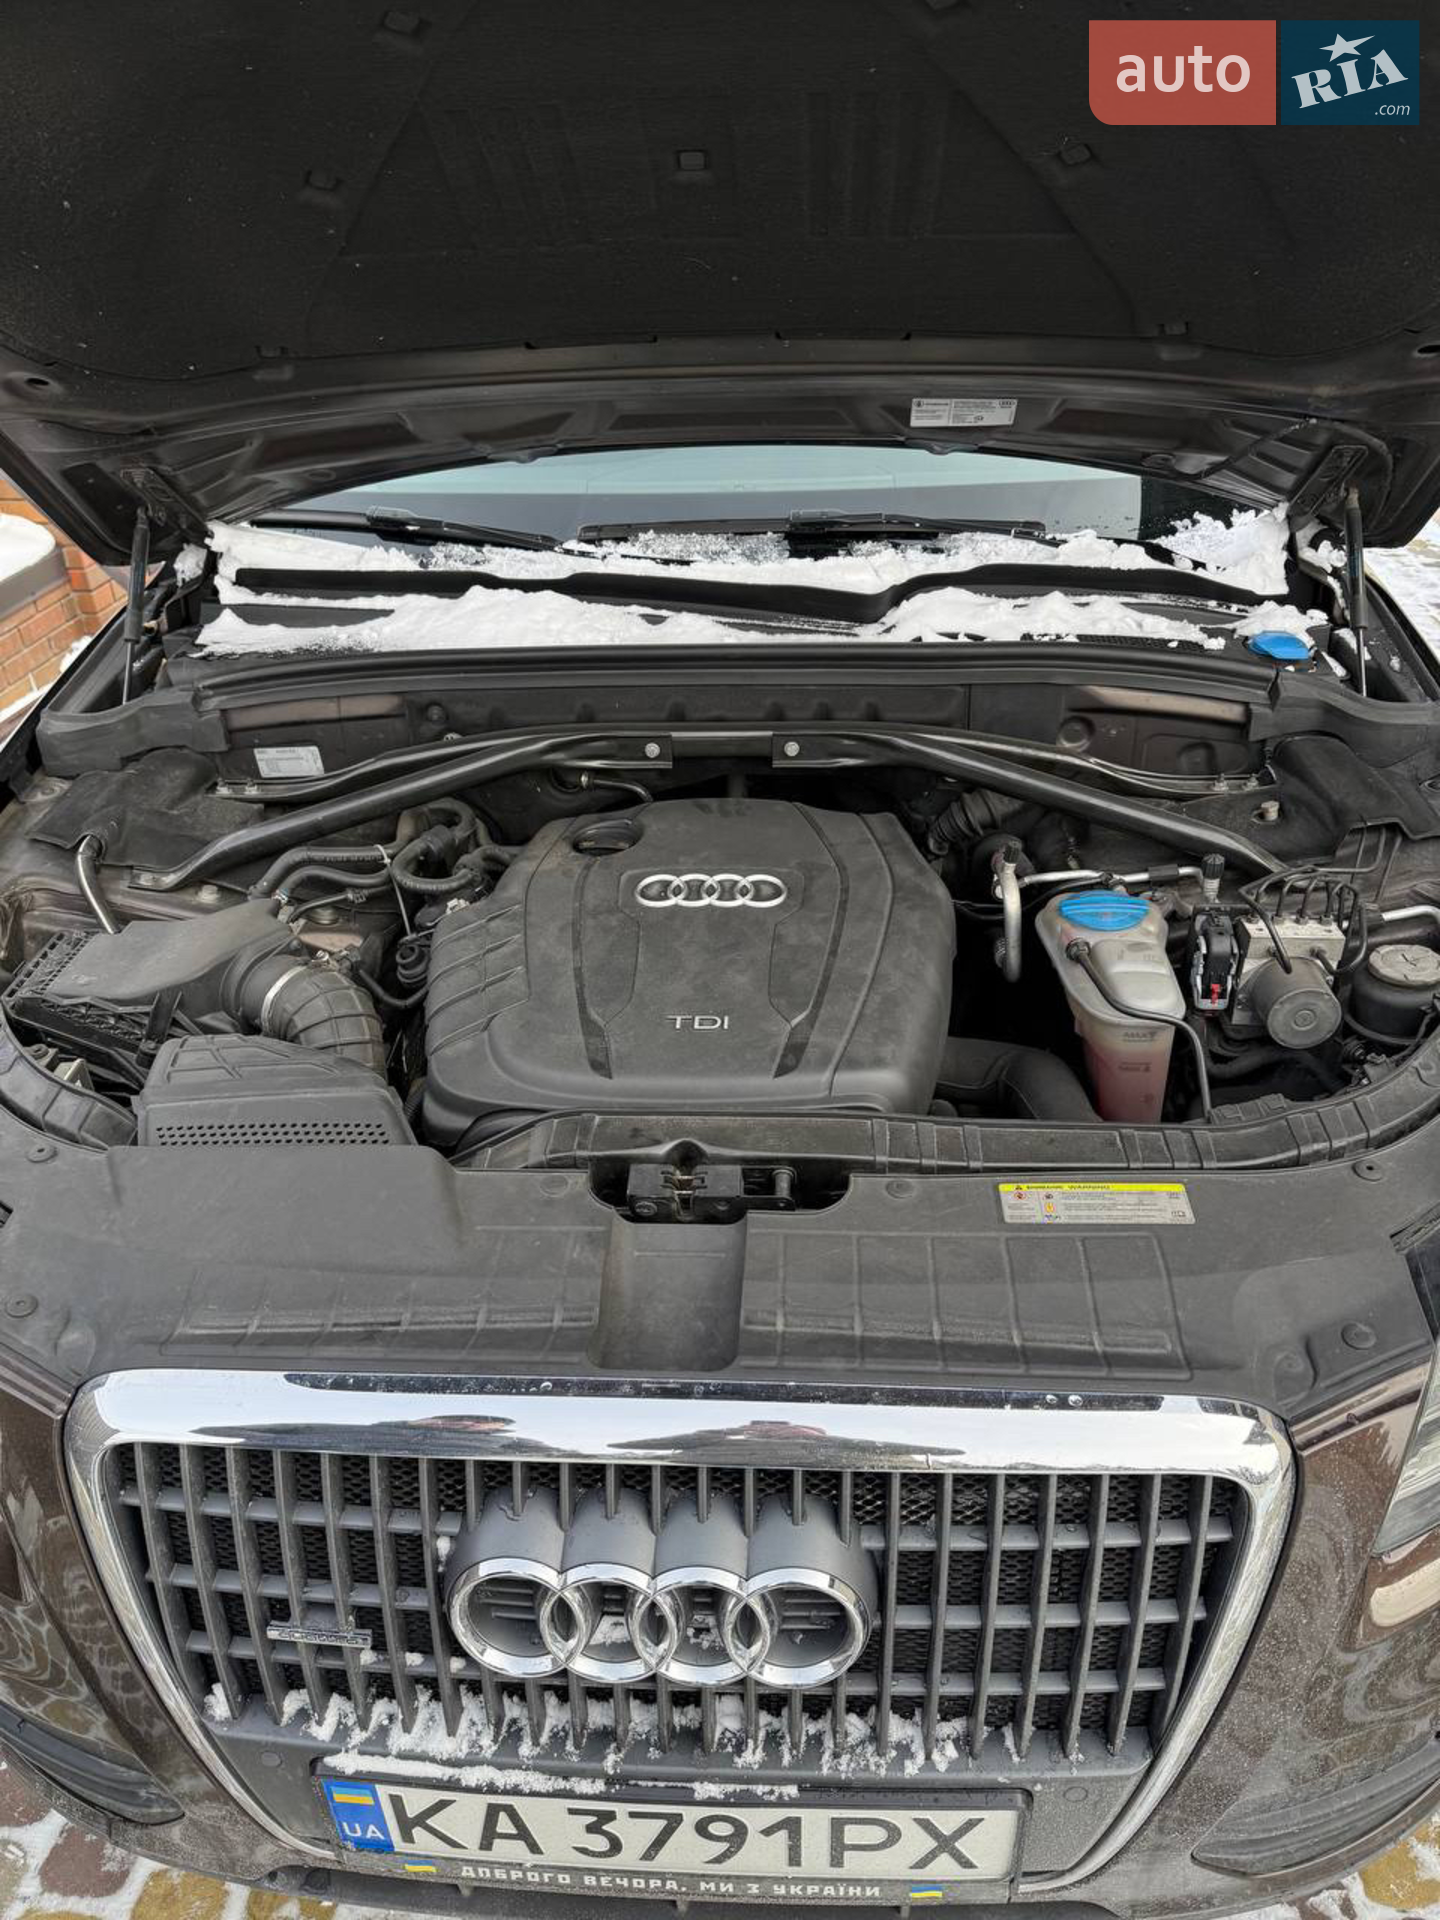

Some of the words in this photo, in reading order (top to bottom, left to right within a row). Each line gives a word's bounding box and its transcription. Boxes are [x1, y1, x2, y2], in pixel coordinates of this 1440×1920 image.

[666, 1015, 729, 1030] TDI
[341, 1821, 385, 1840] UA
[389, 1794, 544, 1855] KA
[566, 1807, 802, 1868] 3791
[829, 1816, 986, 1870] PX
[461, 1865, 571, 1884] ДОБРОГО
[700, 1881, 734, 1893] МИ
[773, 1883, 881, 1897] УКРАЇНИ
